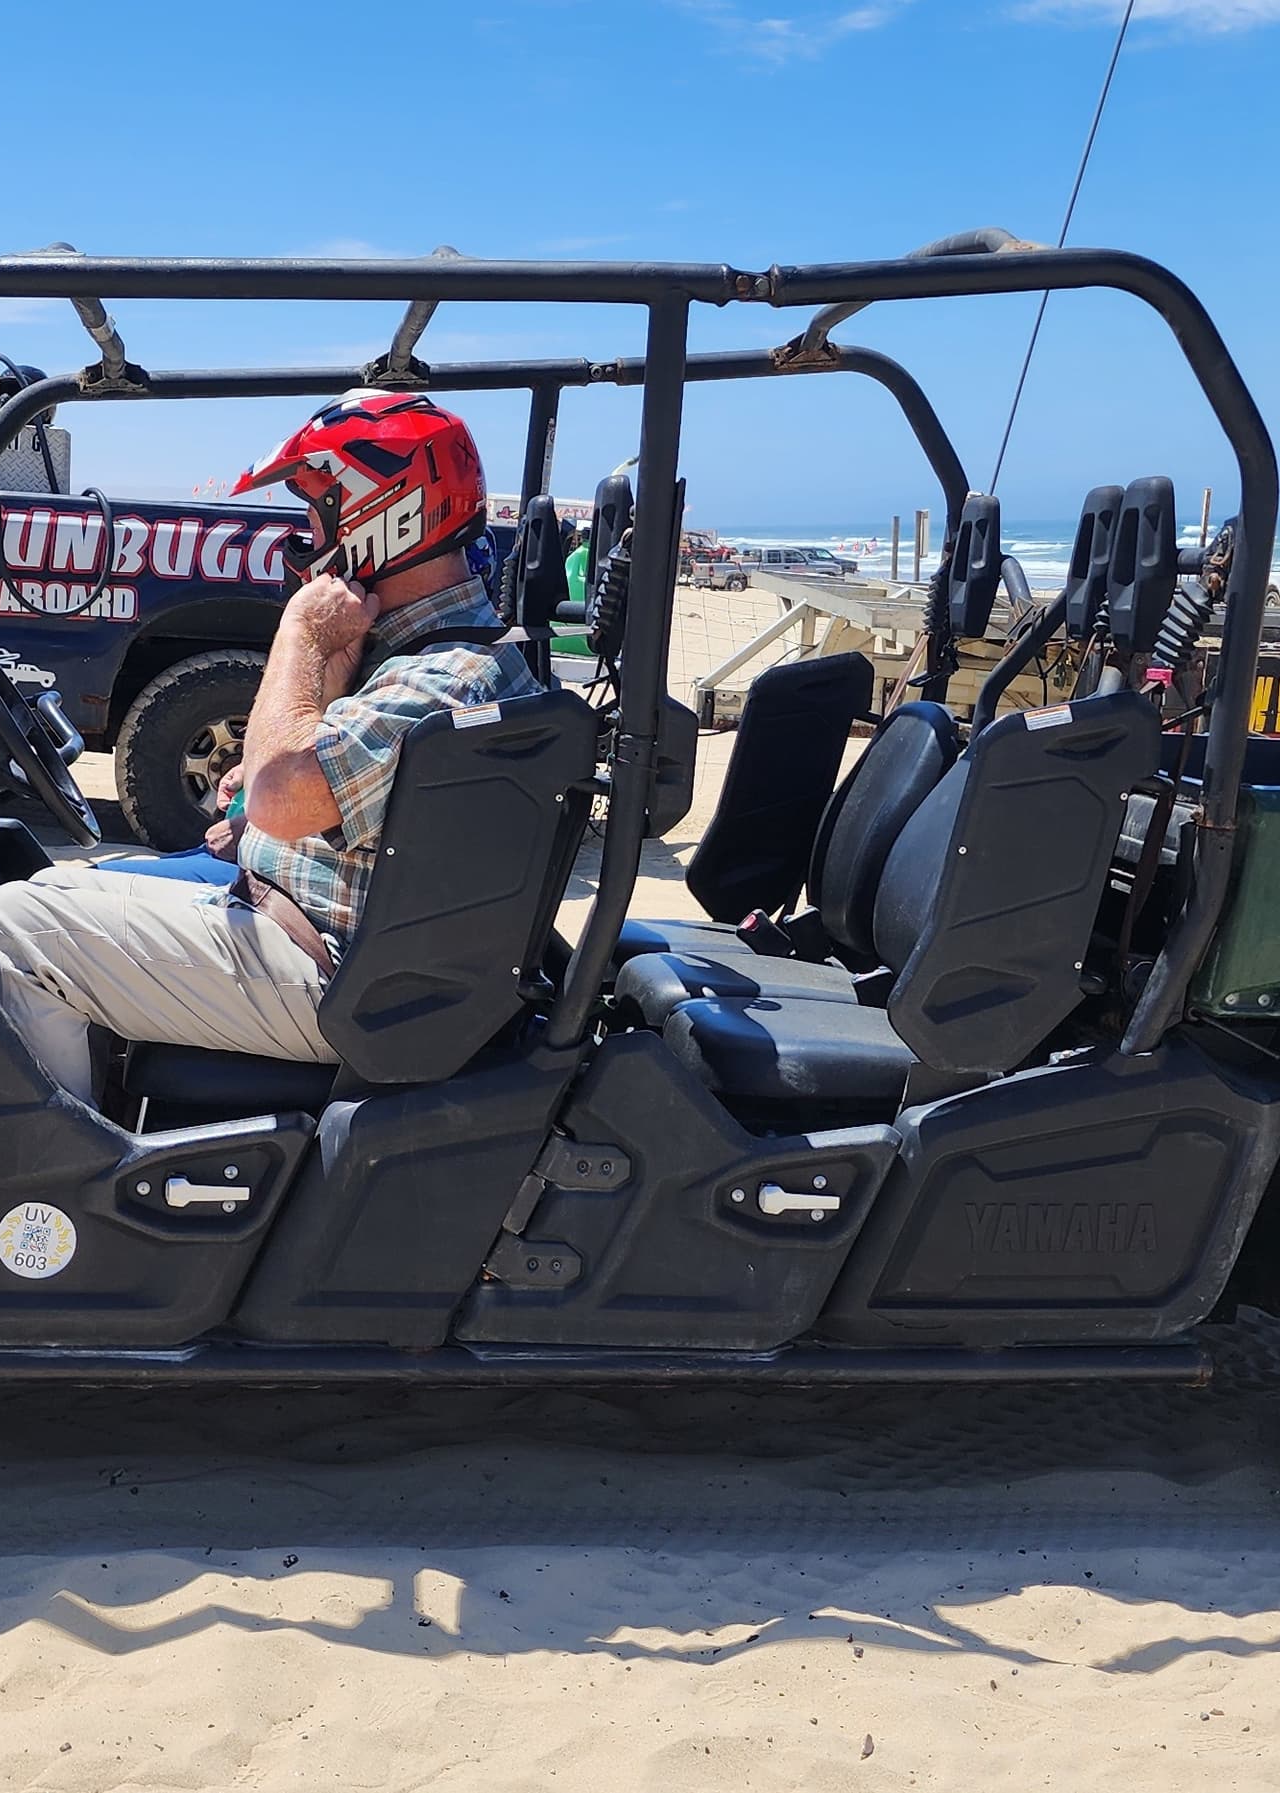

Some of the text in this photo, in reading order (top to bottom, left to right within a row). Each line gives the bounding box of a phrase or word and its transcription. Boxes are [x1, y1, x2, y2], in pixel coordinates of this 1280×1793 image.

[24, 1206, 52, 1225] UV
[963, 1202, 1158, 1252] YAMAHA
[14, 1252, 48, 1271] 603
